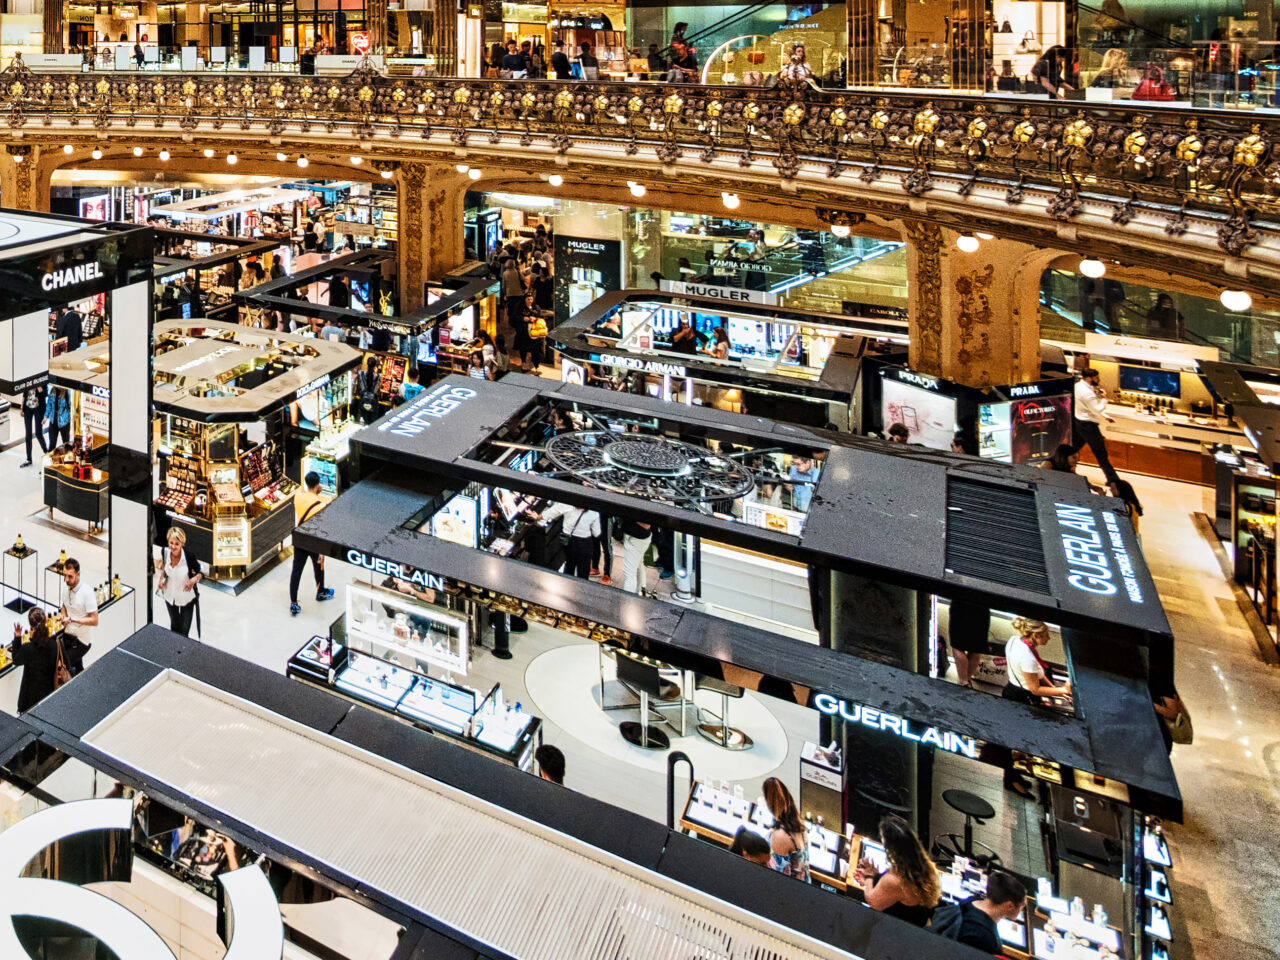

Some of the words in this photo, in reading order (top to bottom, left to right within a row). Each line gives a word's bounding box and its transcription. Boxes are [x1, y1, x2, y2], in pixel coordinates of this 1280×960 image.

[568, 241, 606, 251] MUGLER
[42, 262, 104, 291] CHANEL
[684, 285, 750, 302] MUGLER
[600, 353, 644, 369] GIORGIO
[644, 360, 686, 377] ARMANI
[898, 370, 939, 390] PRADA
[1010, 386, 1041, 397] PRADA
[390, 386, 478, 438] GUERLAIN
[1054, 502, 1118, 596] GUERLAIN
[346, 549, 445, 593] GUERLAIN
[813, 693, 977, 759] GUERLAIN
